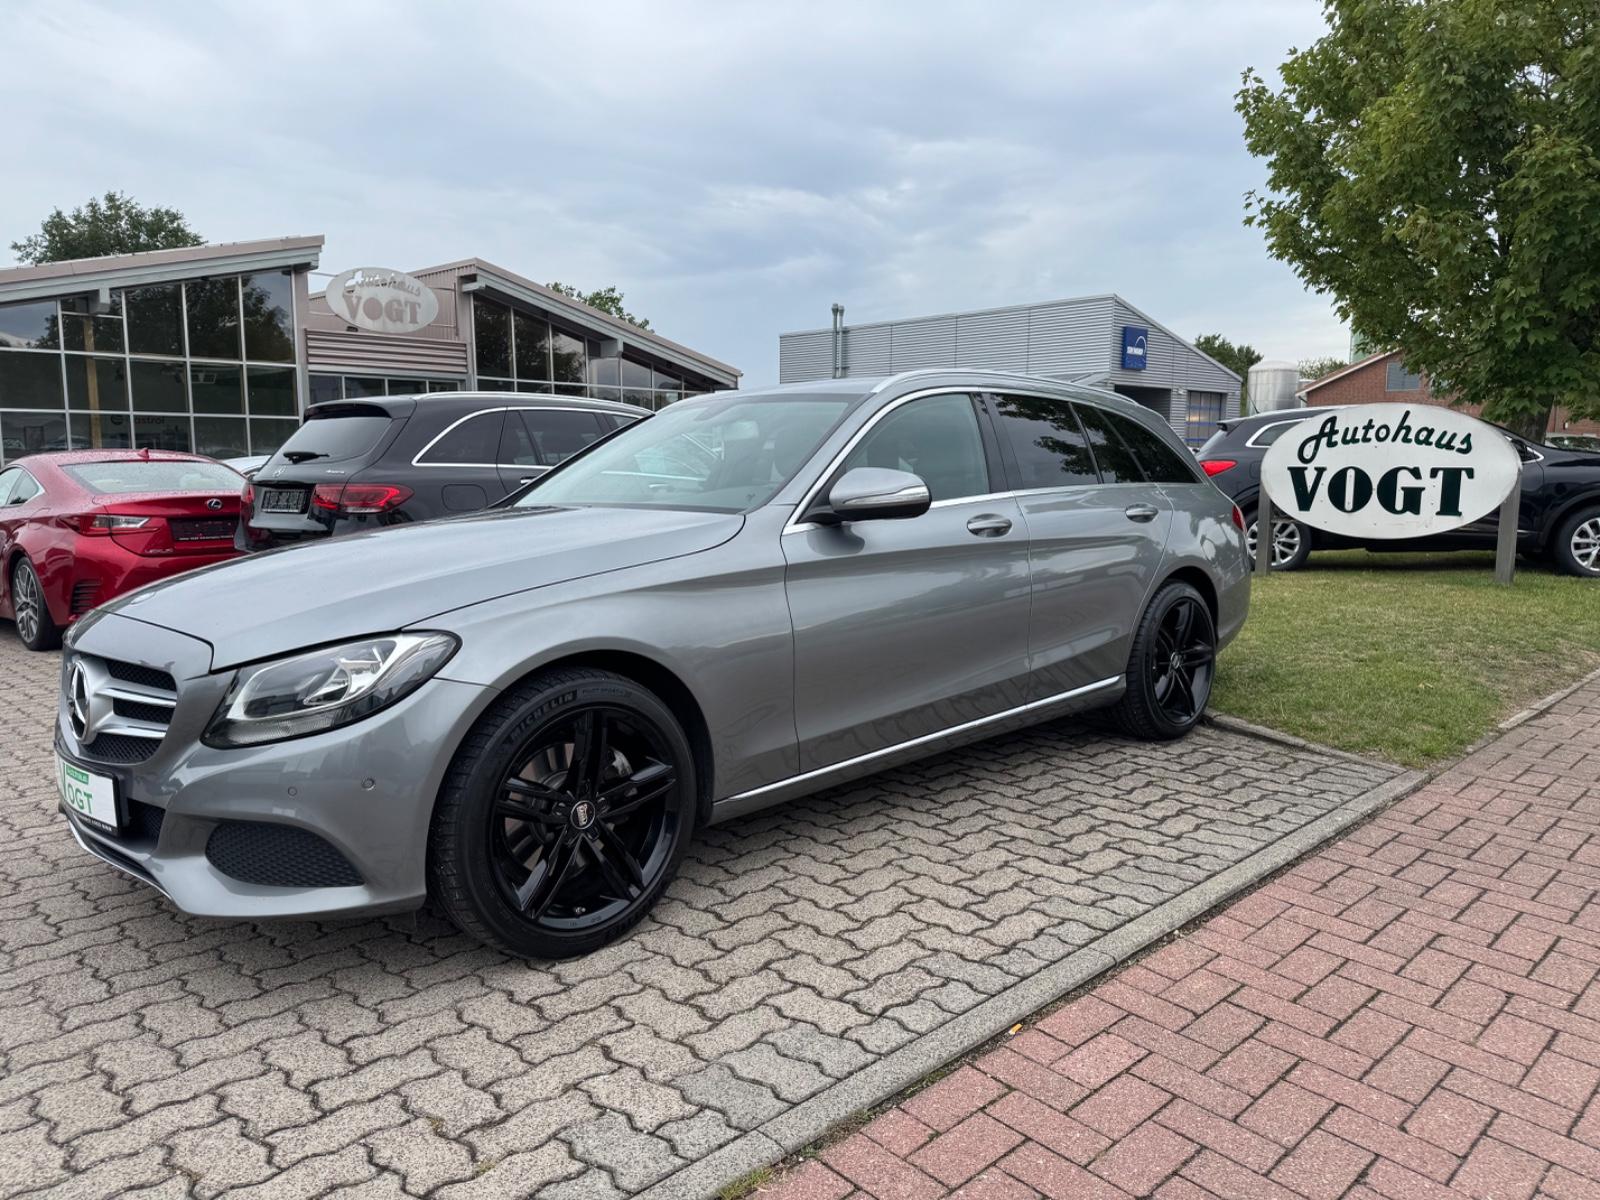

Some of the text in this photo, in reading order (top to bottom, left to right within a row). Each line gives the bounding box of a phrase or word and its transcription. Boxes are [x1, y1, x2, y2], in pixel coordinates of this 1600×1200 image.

[342, 293, 421, 325] VOGT
[130, 415, 165, 425] astrol
[1297, 410, 1473, 464] Autohaus
[1287, 466, 1475, 517] VOGT
[509, 690, 576, 741] MICHELIN
